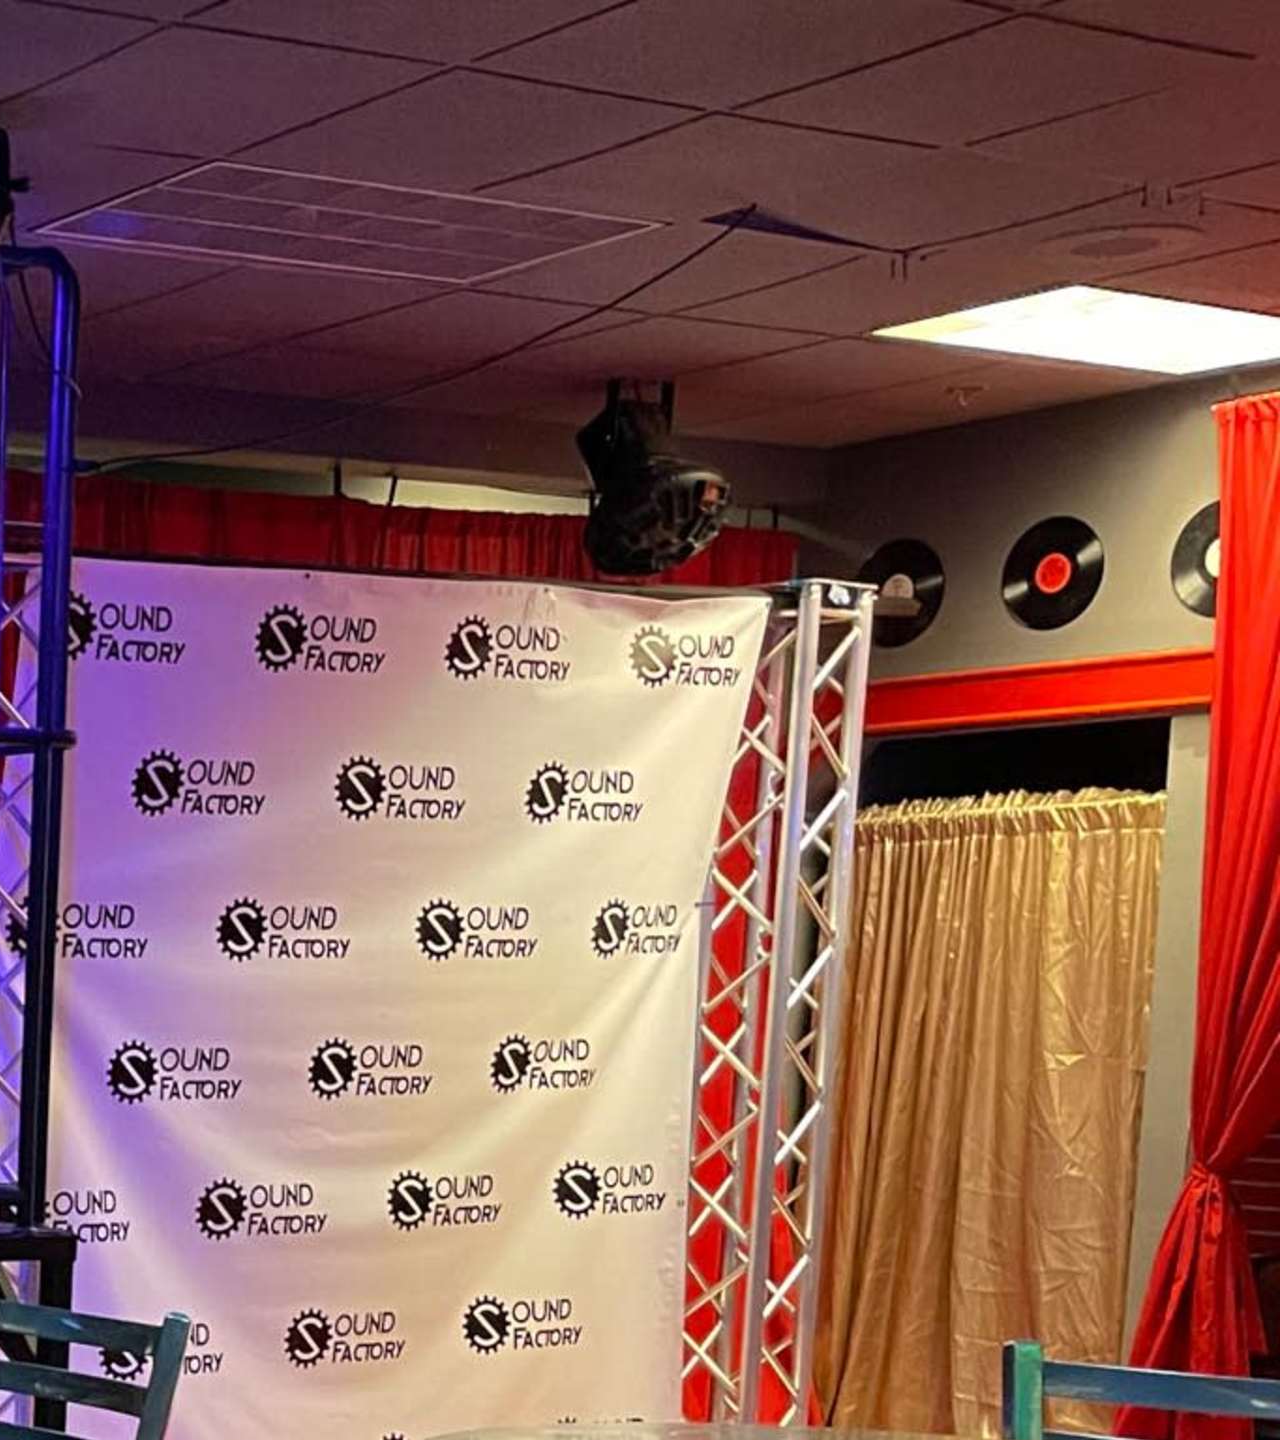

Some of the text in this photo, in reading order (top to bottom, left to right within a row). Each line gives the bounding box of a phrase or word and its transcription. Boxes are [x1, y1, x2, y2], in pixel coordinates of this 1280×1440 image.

[95, 634, 186, 664] FACTORY
[304, 645, 386, 673] FACTORY
[493, 653, 571, 681] FACTORY
[675, 662, 742, 686] FACTORY
[180, 788, 266, 815] FACTORY
[386, 794, 467, 820] FACTORY
[567, 797, 644, 822] FACTORY
[60, 932, 149, 960] FACTORY
[268, 933, 351, 959] FACTORY
[464, 934, 539, 959] FACTORY
[625, 932, 682, 955] FACTORY
[159, 1076, 243, 1101] FACTORY
[355, 1072, 434, 1096] FACTORY
[529, 1066, 597, 1090] FACTORY
[432, 1203, 502, 1226] FACTORY
[602, 1192, 666, 1215] FACTORY
[247, 1212, 328, 1236] FACTORY
[512, 1326, 583, 1351] FACTORY
[332, 1340, 406, 1363] FACTORY
